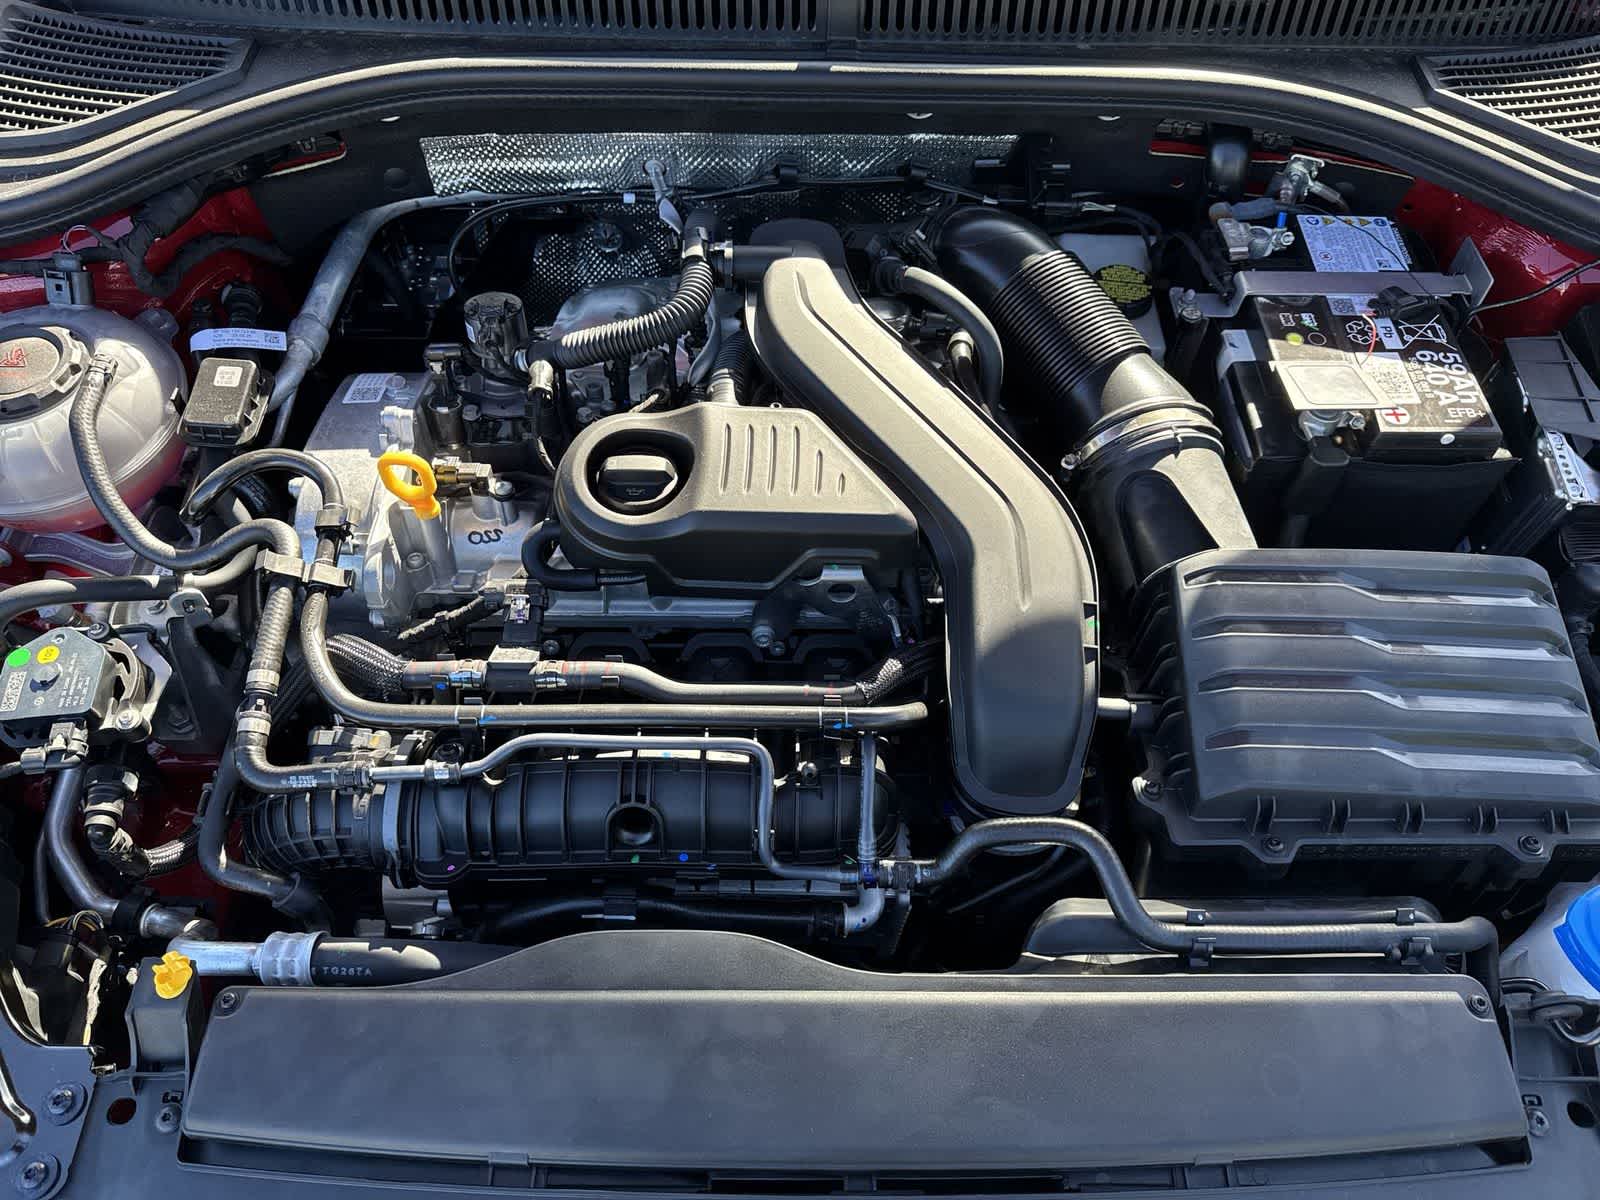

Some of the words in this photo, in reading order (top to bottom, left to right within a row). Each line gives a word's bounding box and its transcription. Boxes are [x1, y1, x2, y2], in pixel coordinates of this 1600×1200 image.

[1381, 326, 1393, 339] Pb
[1416, 350, 1448, 386] 640
[1434, 387, 1455, 407] A
[1439, 352, 1479, 404] 59Ah
